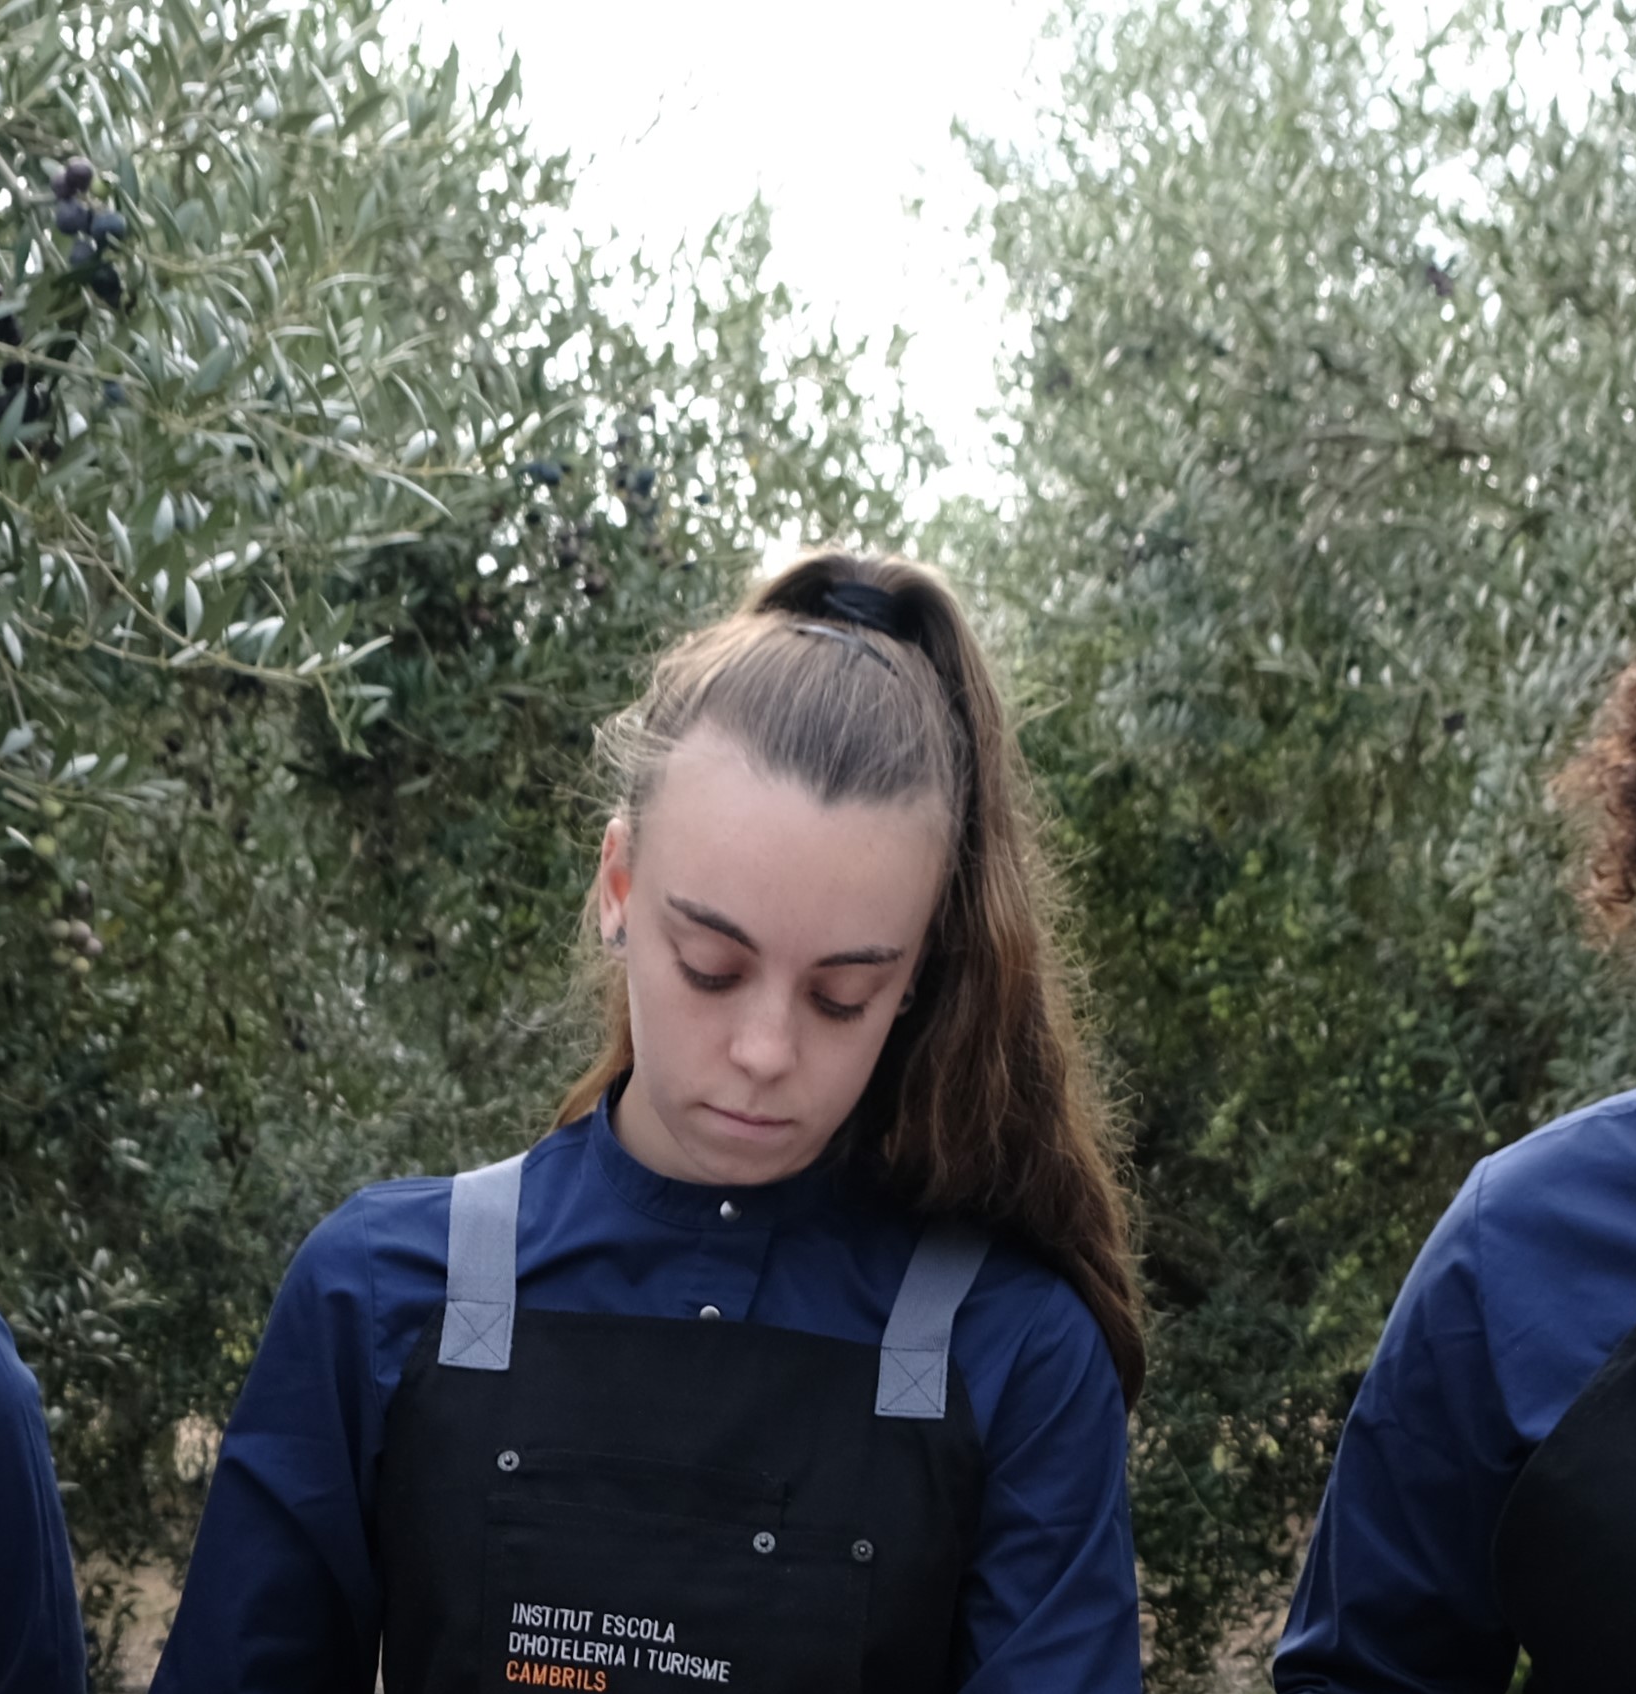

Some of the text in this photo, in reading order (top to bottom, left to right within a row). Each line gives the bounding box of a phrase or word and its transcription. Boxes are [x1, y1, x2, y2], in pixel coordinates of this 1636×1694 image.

[511, 1602, 676, 1643] INSTITUT ESCOLA
[506, 1660, 607, 1692] CAMBRILS
[508, 1632, 731, 1683] D'HOTELERIA I TURISME
